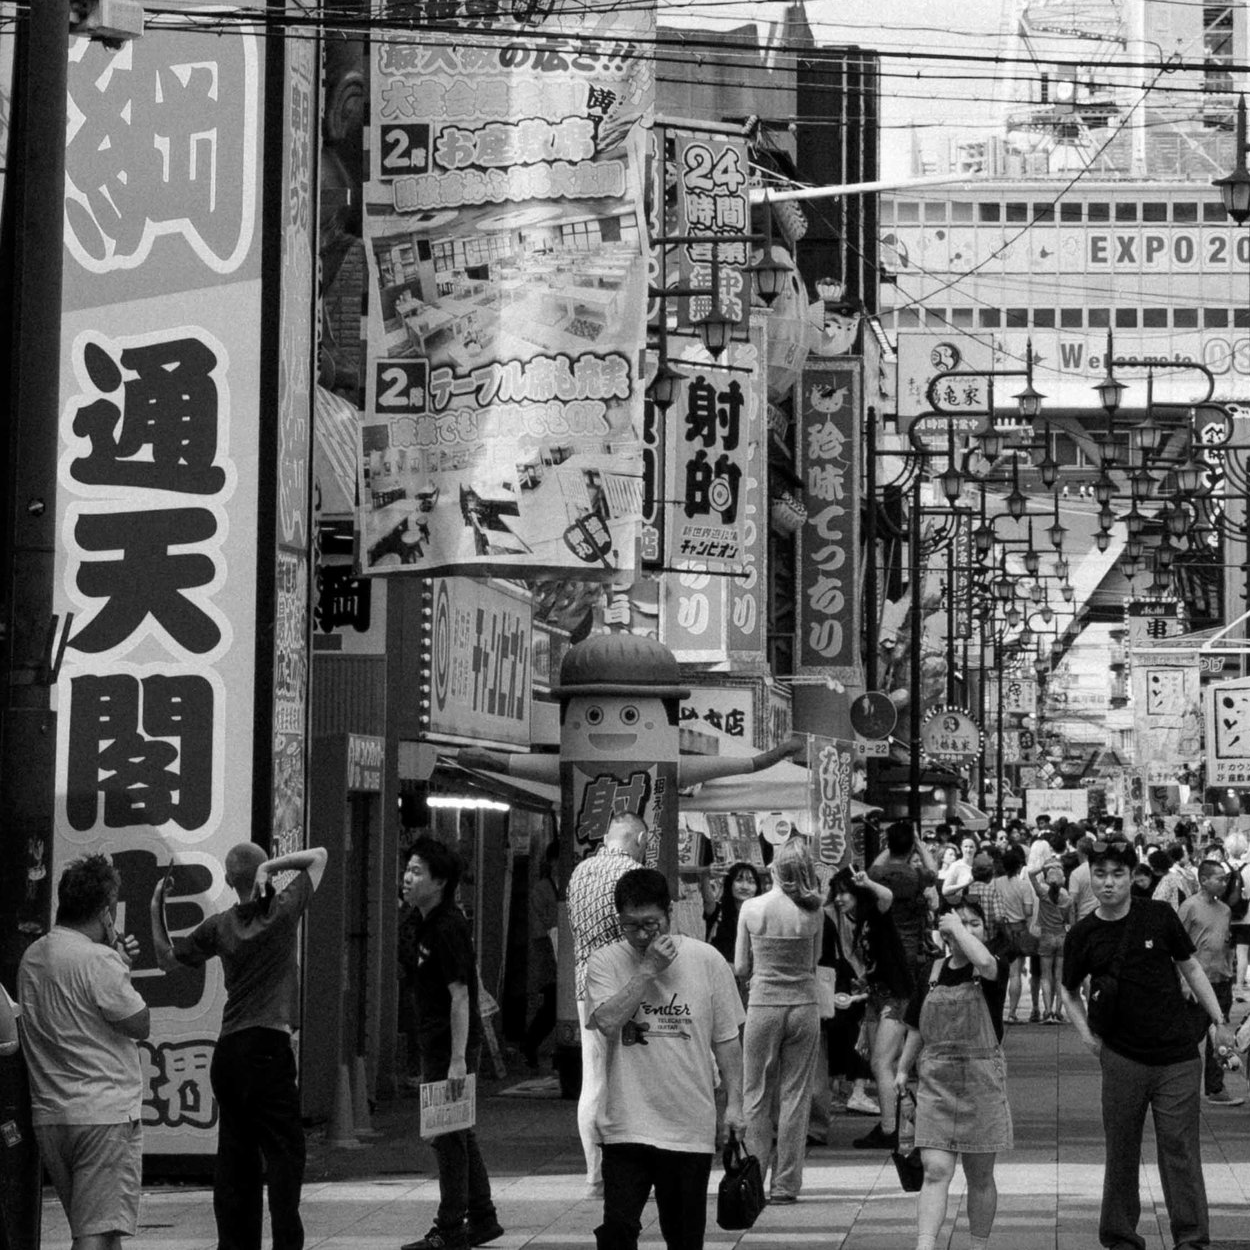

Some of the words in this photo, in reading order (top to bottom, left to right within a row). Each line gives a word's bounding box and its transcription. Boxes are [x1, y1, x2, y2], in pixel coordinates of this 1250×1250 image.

[684, 144, 746, 193] 24
[686, 192, 746, 230] 時間
[1090, 236, 1194, 264] EXPO
[684, 374, 745, 525] 射的
[680, 539, 739, 560] チャンピオン
